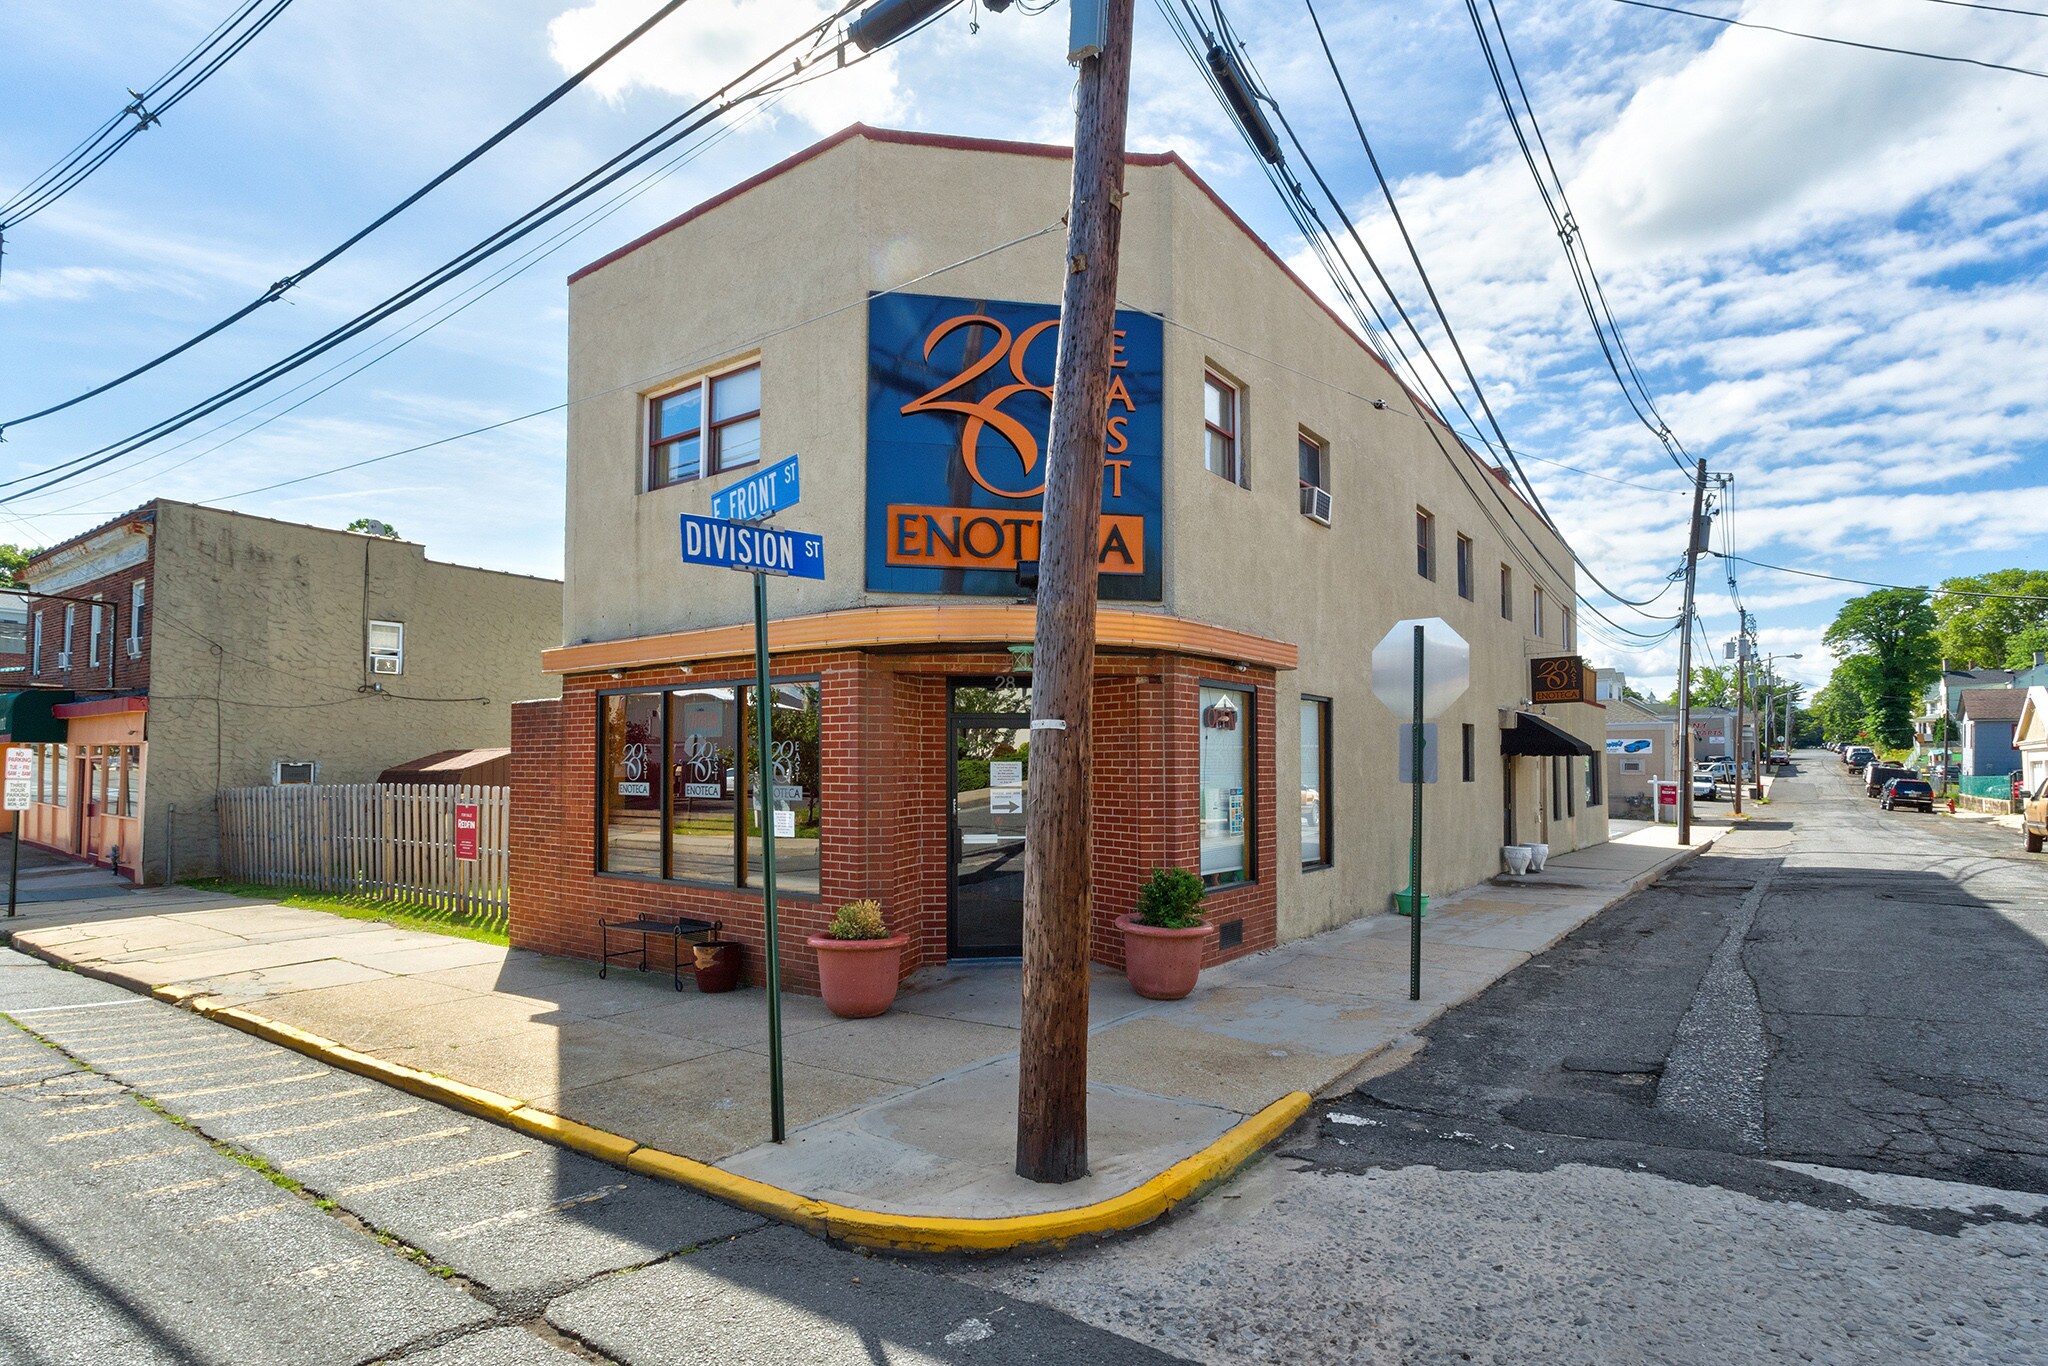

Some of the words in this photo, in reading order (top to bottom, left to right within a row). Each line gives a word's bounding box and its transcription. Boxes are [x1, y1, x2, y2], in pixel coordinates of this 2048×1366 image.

[900, 315, 1062, 498] 28
[1104, 330, 1136, 497] EAST
[713, 498, 721, 518] E
[729, 471, 777, 519] FRONT
[784, 463, 796, 484] ST
[686, 520, 794, 569] DIVISION
[805, 540, 820, 558] ST
[896, 513, 1135, 565] ENOTA
[995, 675, 1016, 691] 28
[1537, 659, 1569, 689] 28
[1537, 691, 1578, 700] ENOTECA
[620, 742, 643, 781] 28
[687, 741, 713, 782] 28
[771, 740, 794, 783] 28
[620, 784, 648, 794] ENOTECA
[686, 786, 719, 796] ENOTECA
[774, 787, 801, 798] OTECA
[458, 819, 475, 829] REDFIN
